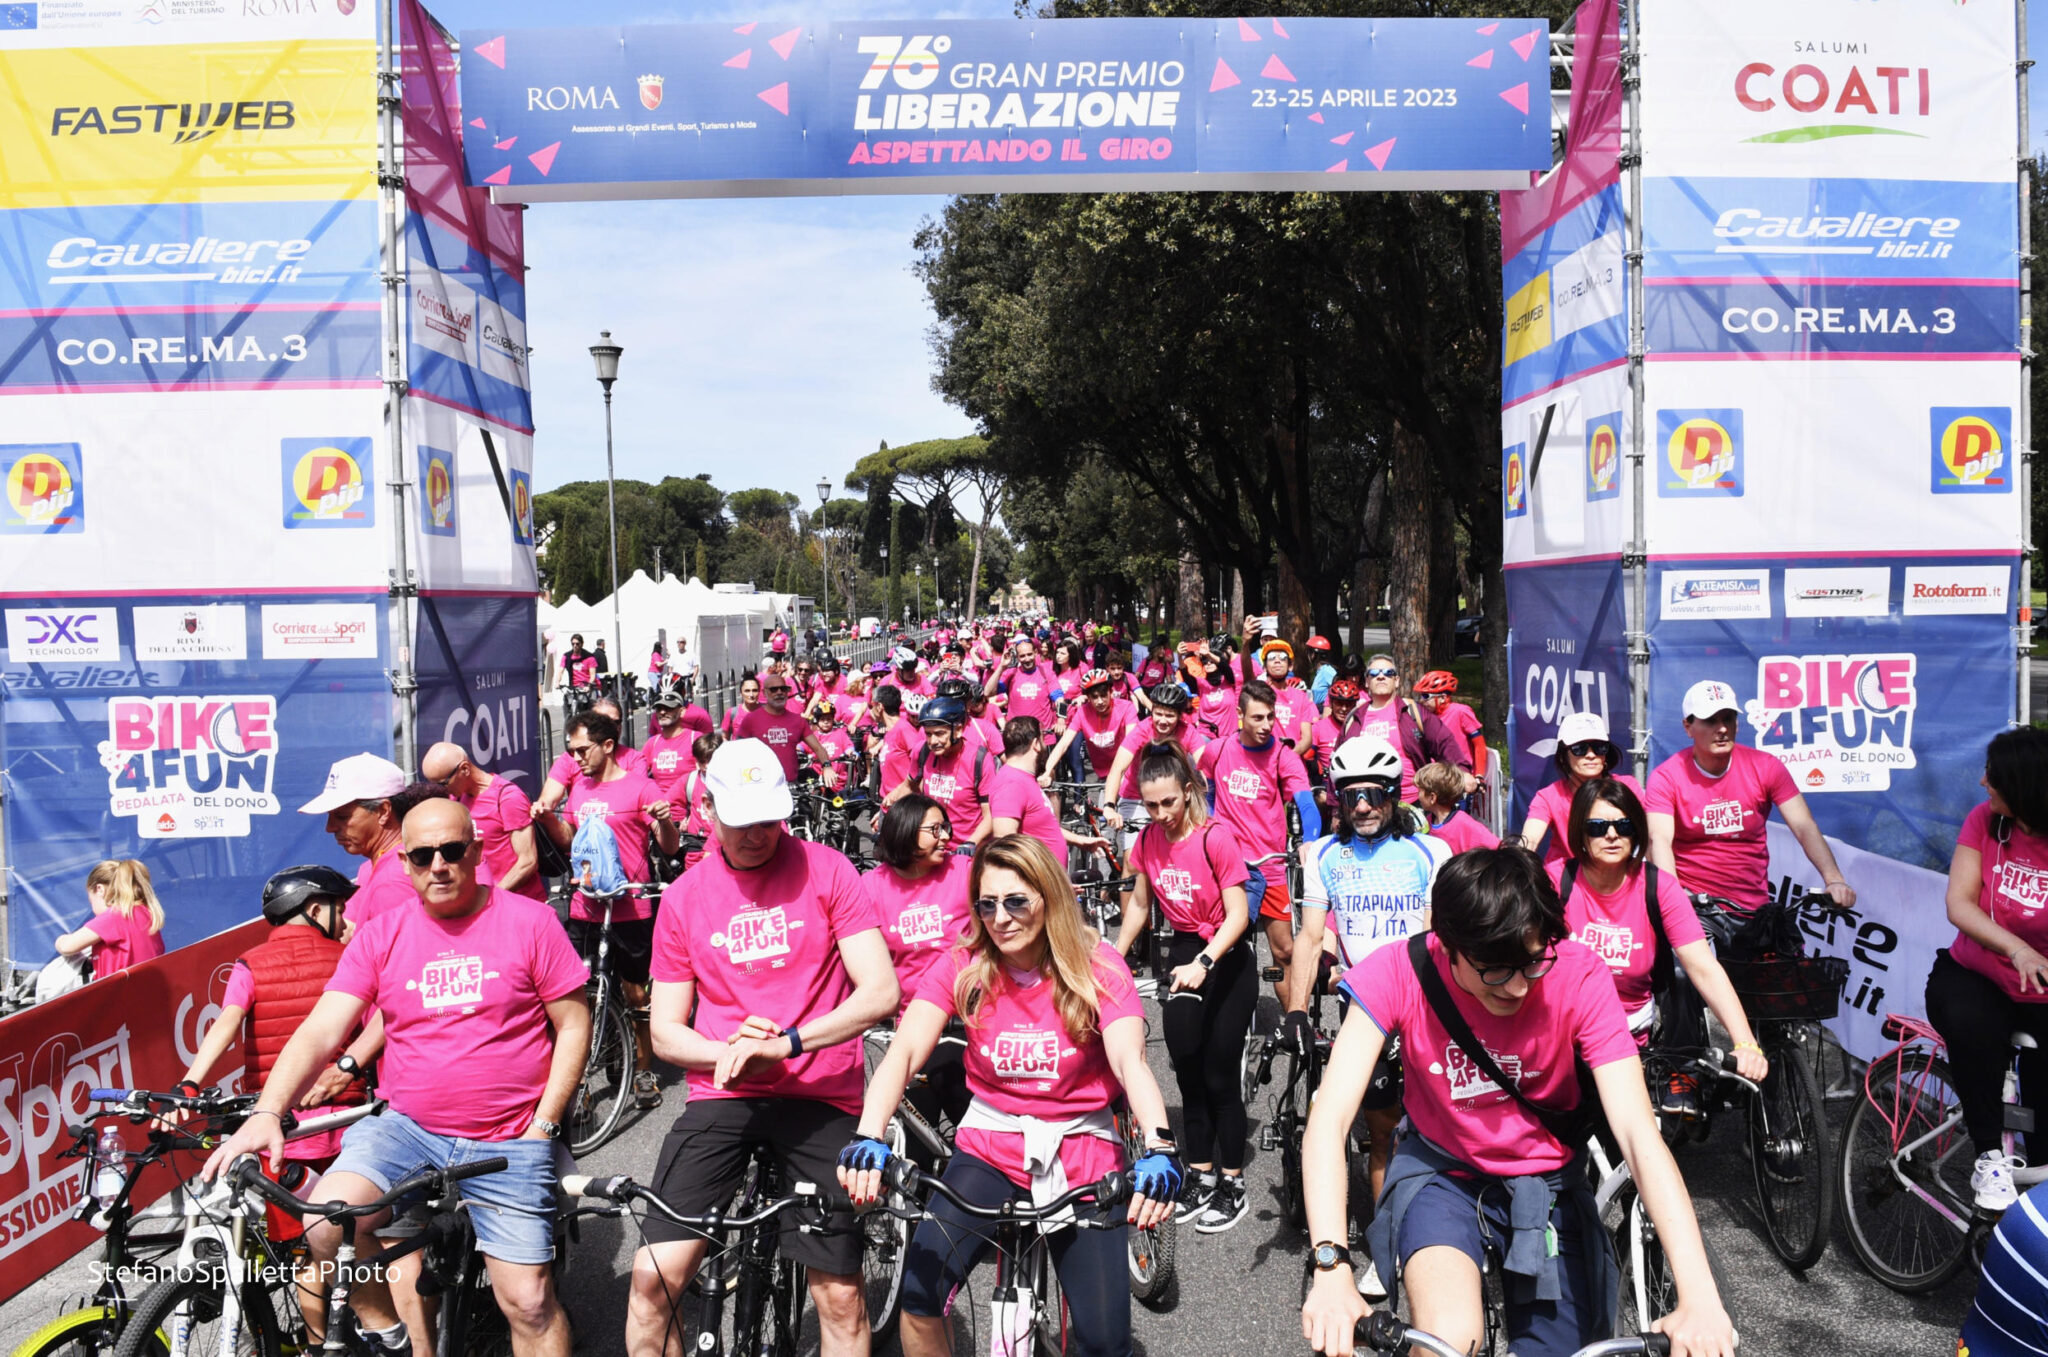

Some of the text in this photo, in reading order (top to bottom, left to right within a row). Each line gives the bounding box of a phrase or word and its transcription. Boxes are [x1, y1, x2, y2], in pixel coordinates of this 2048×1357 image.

[1794, 40, 1868, 54] SALUMI
[949, 60, 1185, 89] GRAN PREMIO
[527, 86, 621, 111] ROMA
[1250, 88, 1458, 108] 23-25 APRILE 2023
[1734, 62, 1930, 116] COATI
[853, 91, 1182, 131] LIBERAZIONE
[50, 100, 296, 145] FASTWEB
[571, 124, 616, 134] Assessorato
[625, 123, 650, 133] Grandi
[700, 121, 729, 131] Turismo
[736, 121, 757, 130] Moda
[848, 137, 1173, 165] ASPETTANDO IL GIRO
[1876, 241, 1955, 259] bici.it
[219, 264, 304, 285] bici.it
[1722, 306, 1956, 335] CO.RE.MA.3
[57, 334, 308, 367] CO.RE.MA.3
[1690, 580, 1746, 591] ARTEMISIA
[25, 615, 99, 644] DXC
[272, 621, 318, 634] Corriere
[334, 621, 366, 638] Sport
[28, 647, 100, 657] TECHNOLOGY
[1546, 638, 1576, 655] SALUMI
[475, 671, 507, 690] SALUMI
[1764, 659, 1911, 709] BIKE
[1525, 663, 1610, 735] COATI
[115, 702, 272, 752] BIKE
[443, 695, 528, 766] COATI
[1762, 705, 1908, 750] 4FUN
[1775, 748, 1906, 764] DALATA DEL DONO
[115, 748, 269, 794] 4FUN
[1231, 773, 1259, 788] BIKE
[116, 793, 268, 811] PEDALATA DEL DONO
[1706, 805, 1740, 821] BIKE
[1706, 817, 1740, 829] 4FUN
[1345, 894, 1421, 913] TRAPIANTO
[731, 913, 785, 940] BIKE
[902, 909, 940, 928] BIKE
[903, 922, 940, 937] 4FUN
[1585, 928, 1630, 949] BIKE
[731, 931, 785, 954] 4FUN
[1594, 944, 1628, 961] FUN
[425, 964, 480, 986] BIKE
[425, 981, 479, 999] 4FUN
[997, 1039, 1057, 1059] BIKE
[997, 1058, 1055, 1073] 4FUN
